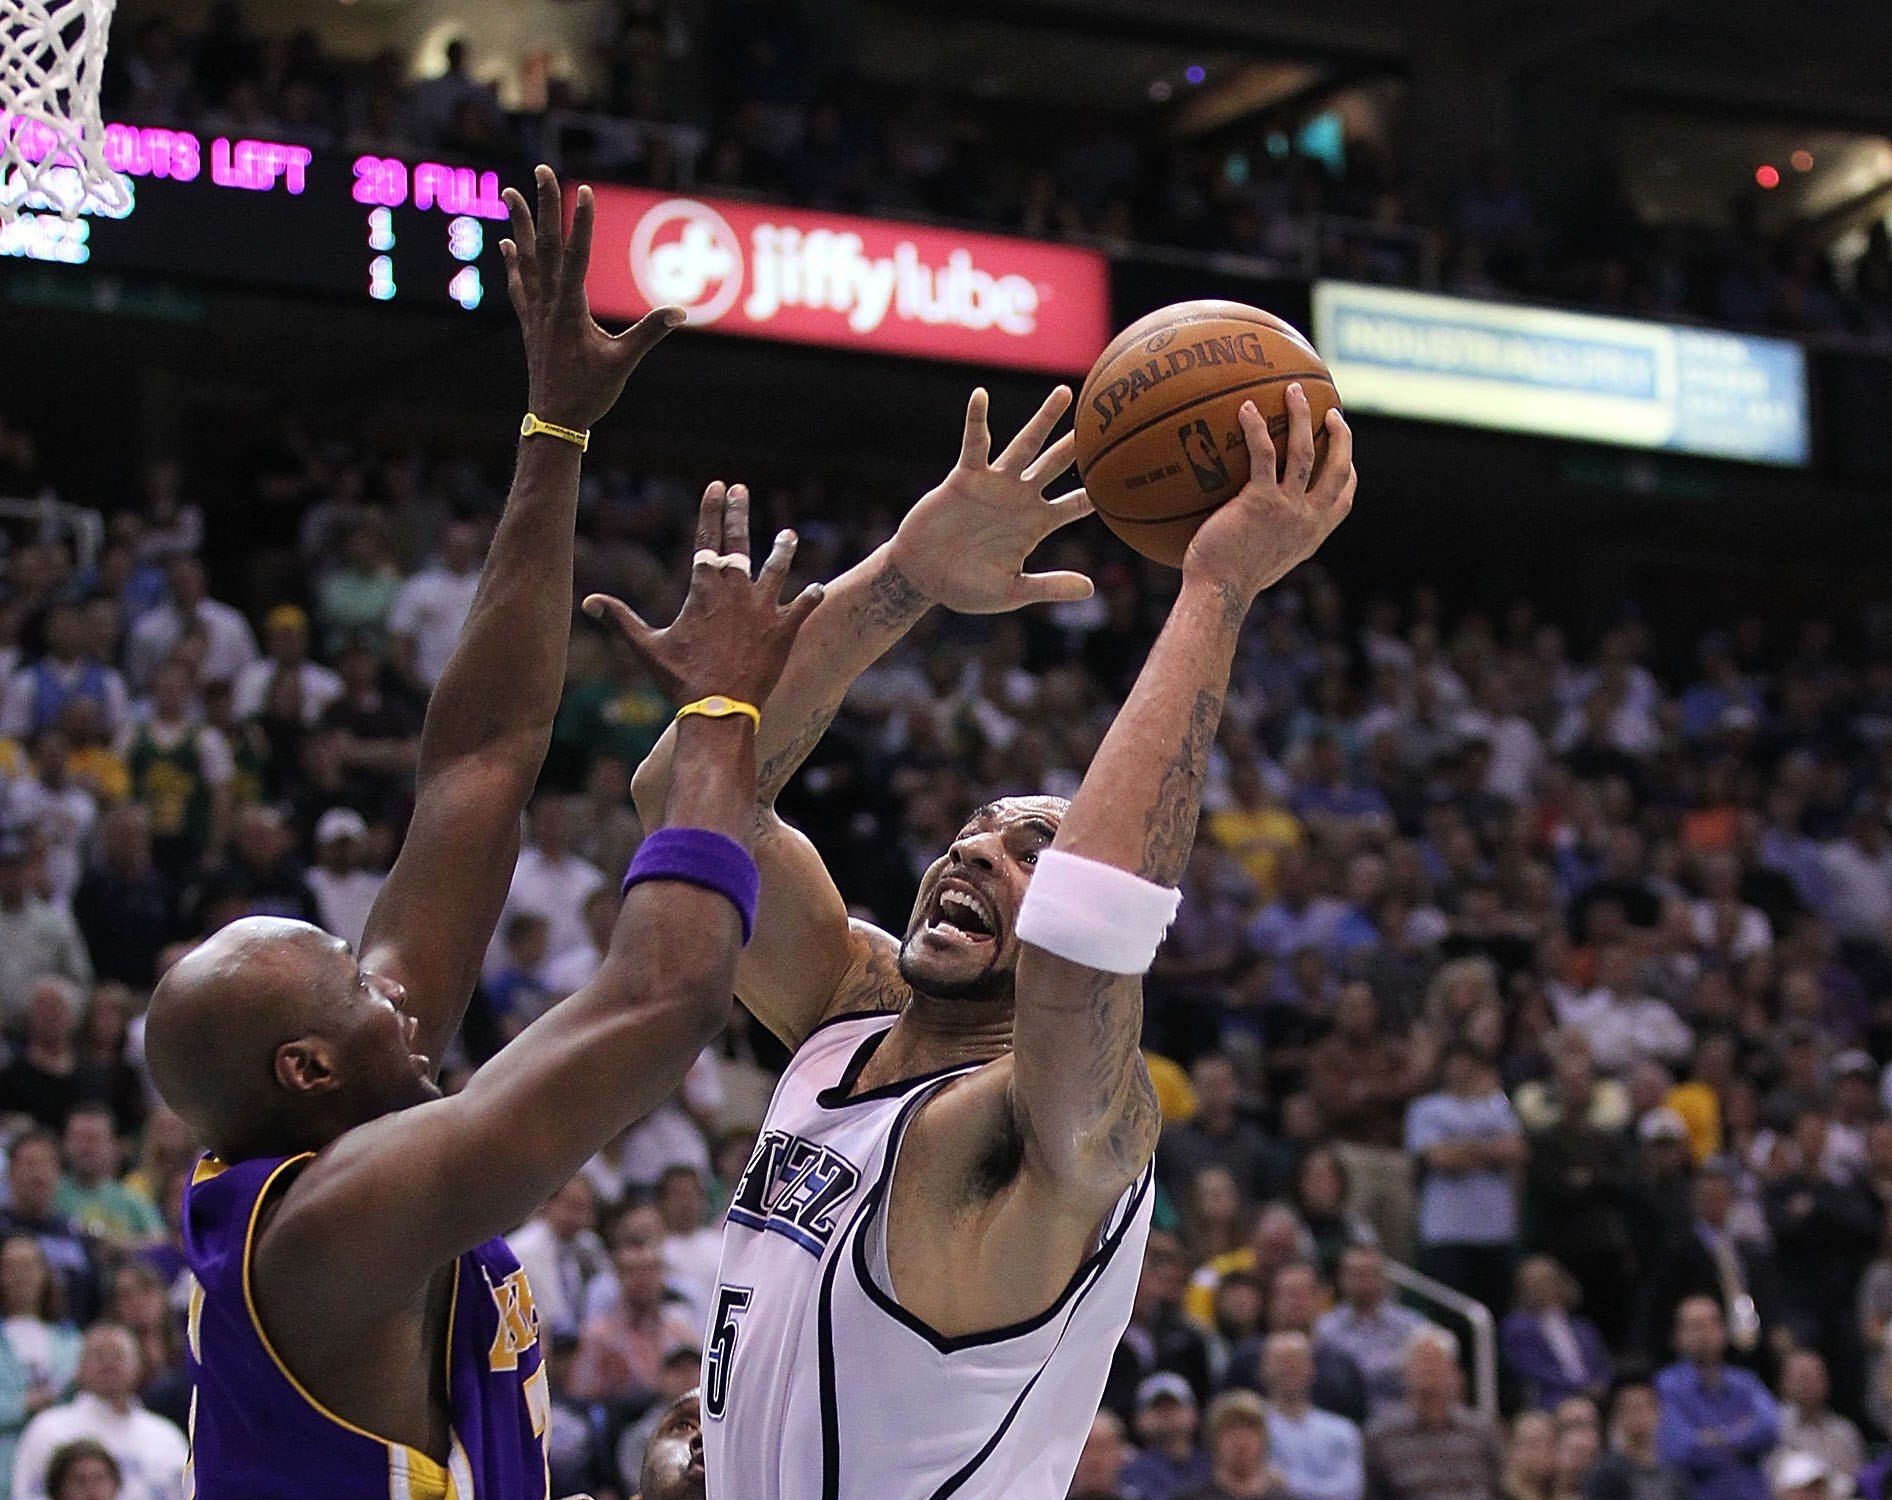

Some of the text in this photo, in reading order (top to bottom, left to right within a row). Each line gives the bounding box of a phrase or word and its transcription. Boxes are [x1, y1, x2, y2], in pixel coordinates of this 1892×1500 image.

[211, 137, 311, 194] LEFT
[368, 206, 396, 251] 1
[369, 254, 484, 311] 1 4
[1093, 332, 1270, 434] SPALDING
[705, 1284, 754, 1422] 5
